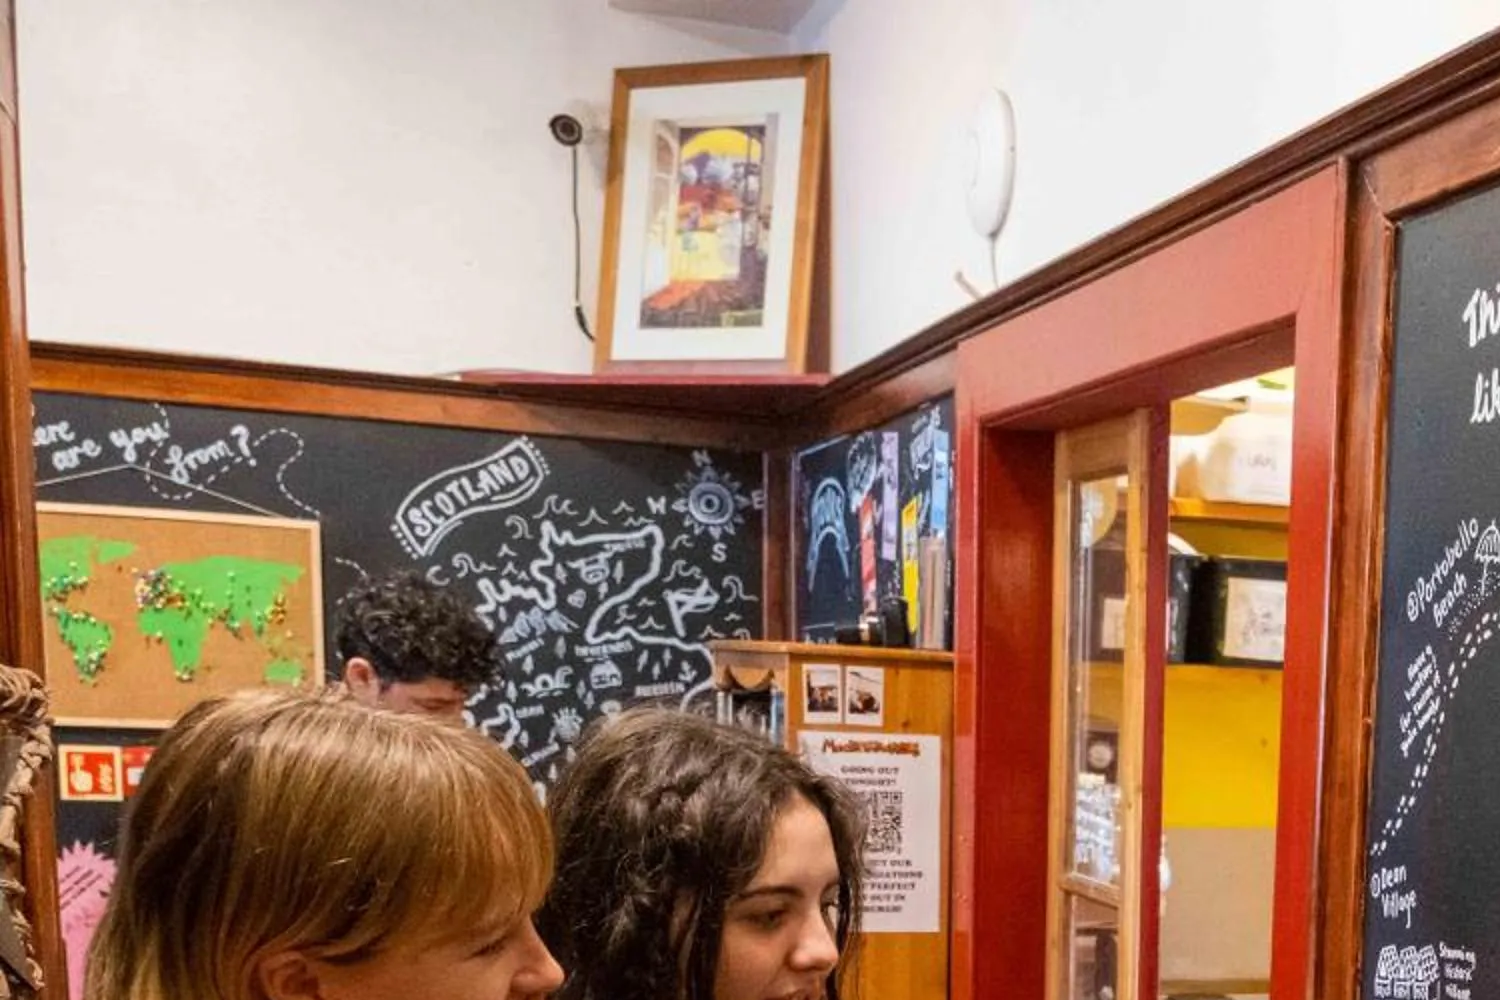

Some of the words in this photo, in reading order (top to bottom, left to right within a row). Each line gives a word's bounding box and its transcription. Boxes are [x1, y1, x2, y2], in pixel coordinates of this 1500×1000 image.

[52, 439, 102, 471] are
[109, 422, 169, 463] you
[408, 455, 530, 537] SCOTLAND
[646, 495, 666, 514] W
[711, 542, 727, 563] S
[1417, 518, 1478, 613] Portobello
